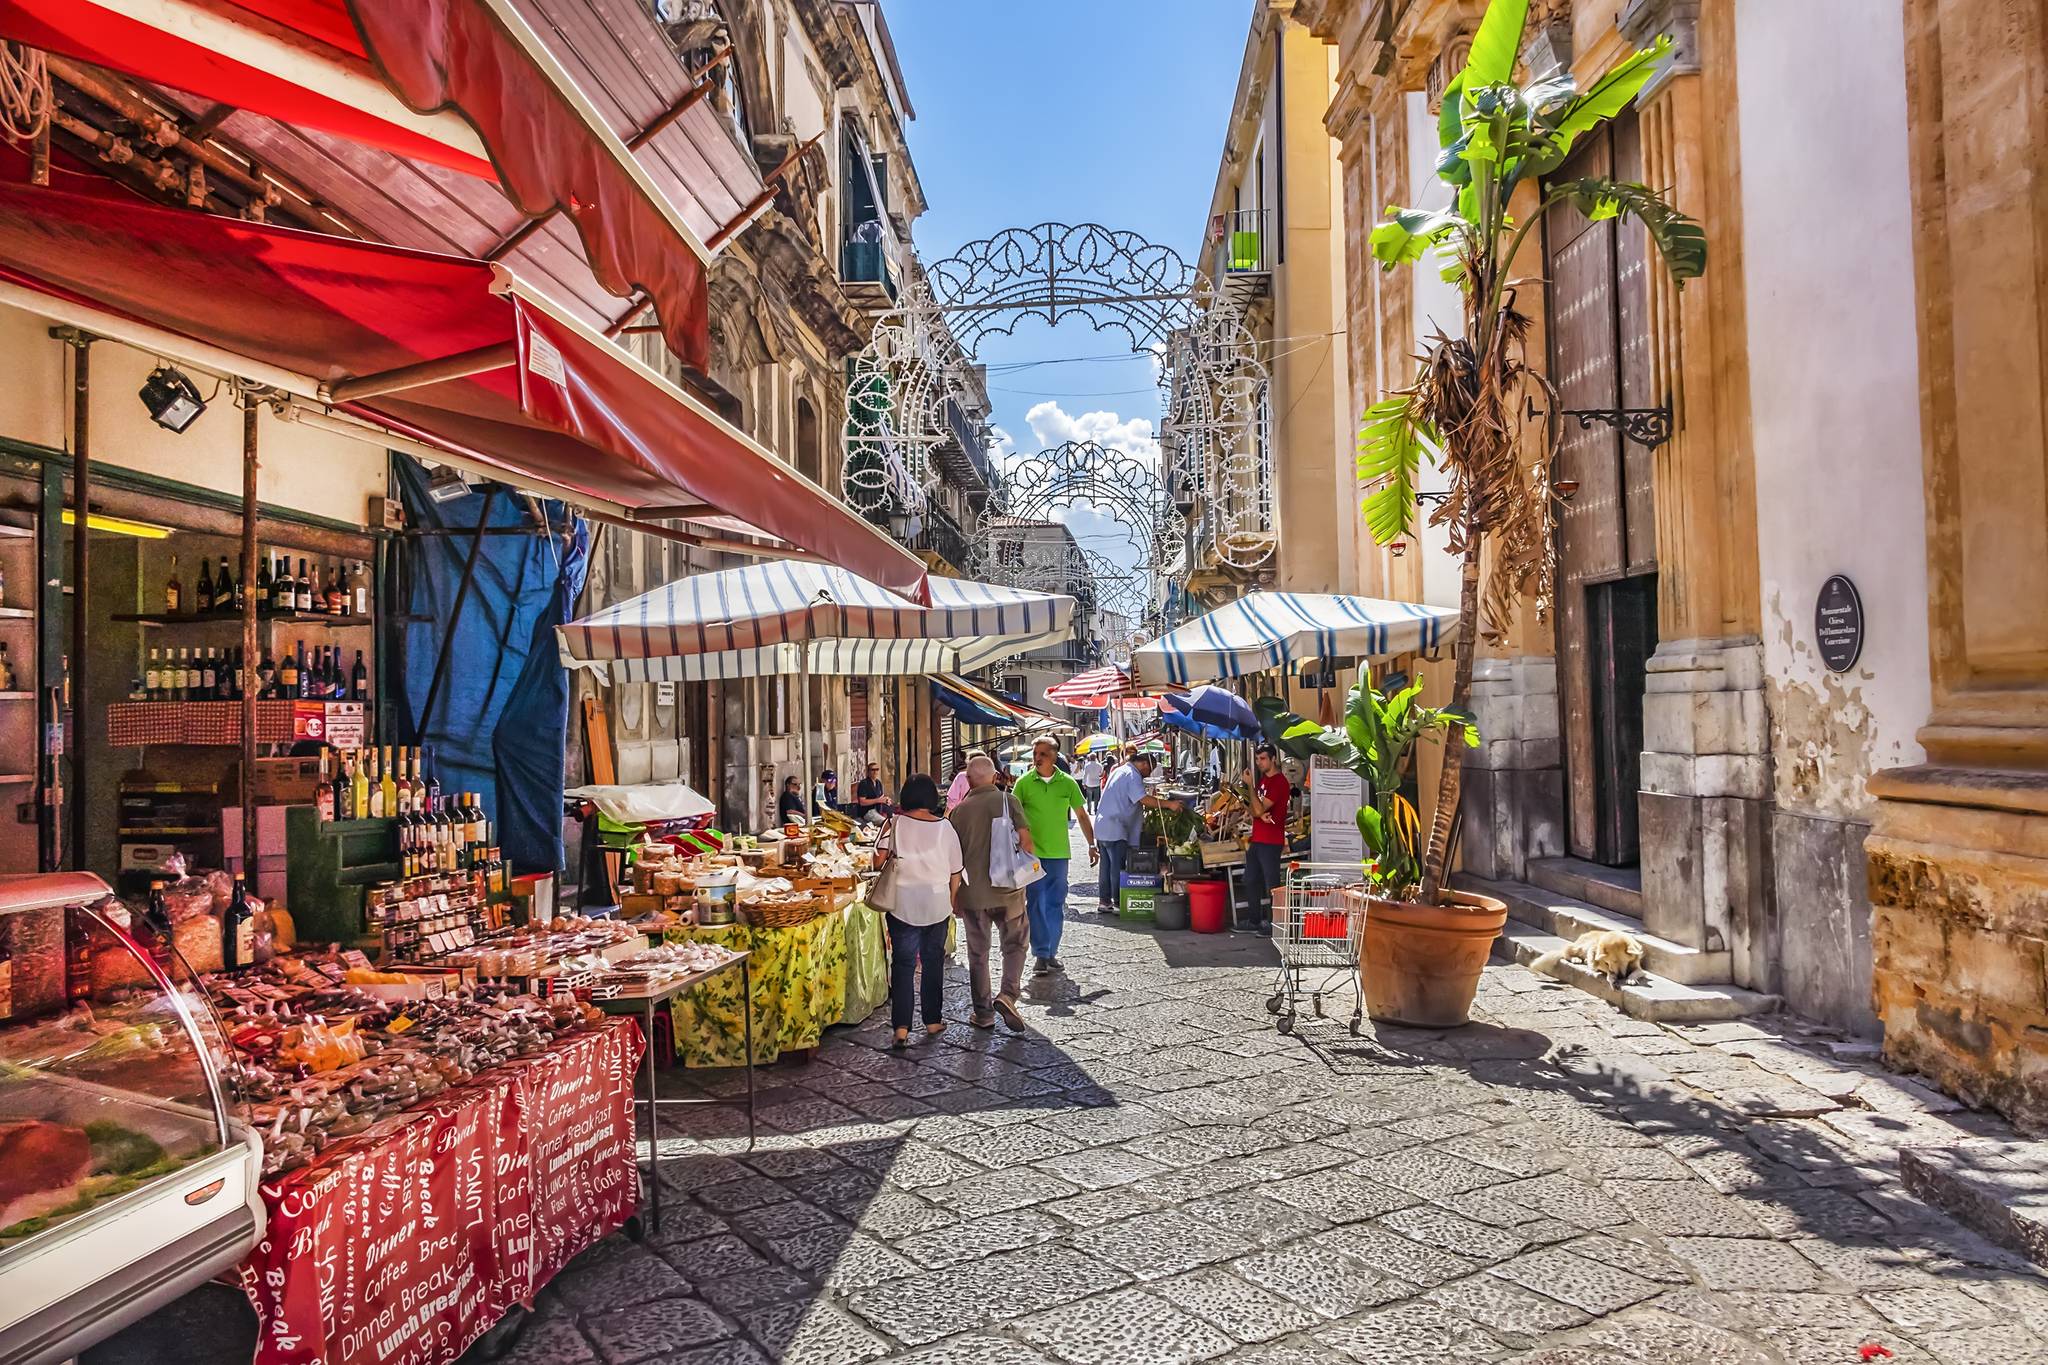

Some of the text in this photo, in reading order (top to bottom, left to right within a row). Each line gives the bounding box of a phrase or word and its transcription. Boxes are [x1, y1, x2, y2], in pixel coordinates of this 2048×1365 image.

[1129, 901, 1153, 909] FORST
[378, 1151, 401, 1224] Coffee
[419, 1158, 440, 1229] Break
[498, 1150, 529, 1177] Din
[361, 1163, 376, 1239] Break
[365, 1219, 416, 1272] Dinner
[266, 1266, 302, 1351] Break
[341, 1236, 356, 1325] Dinner
[365, 1260, 408, 1303] Coffee
[342, 1302, 397, 1362] Dinner
[375, 1313, 420, 1361] Lunch
